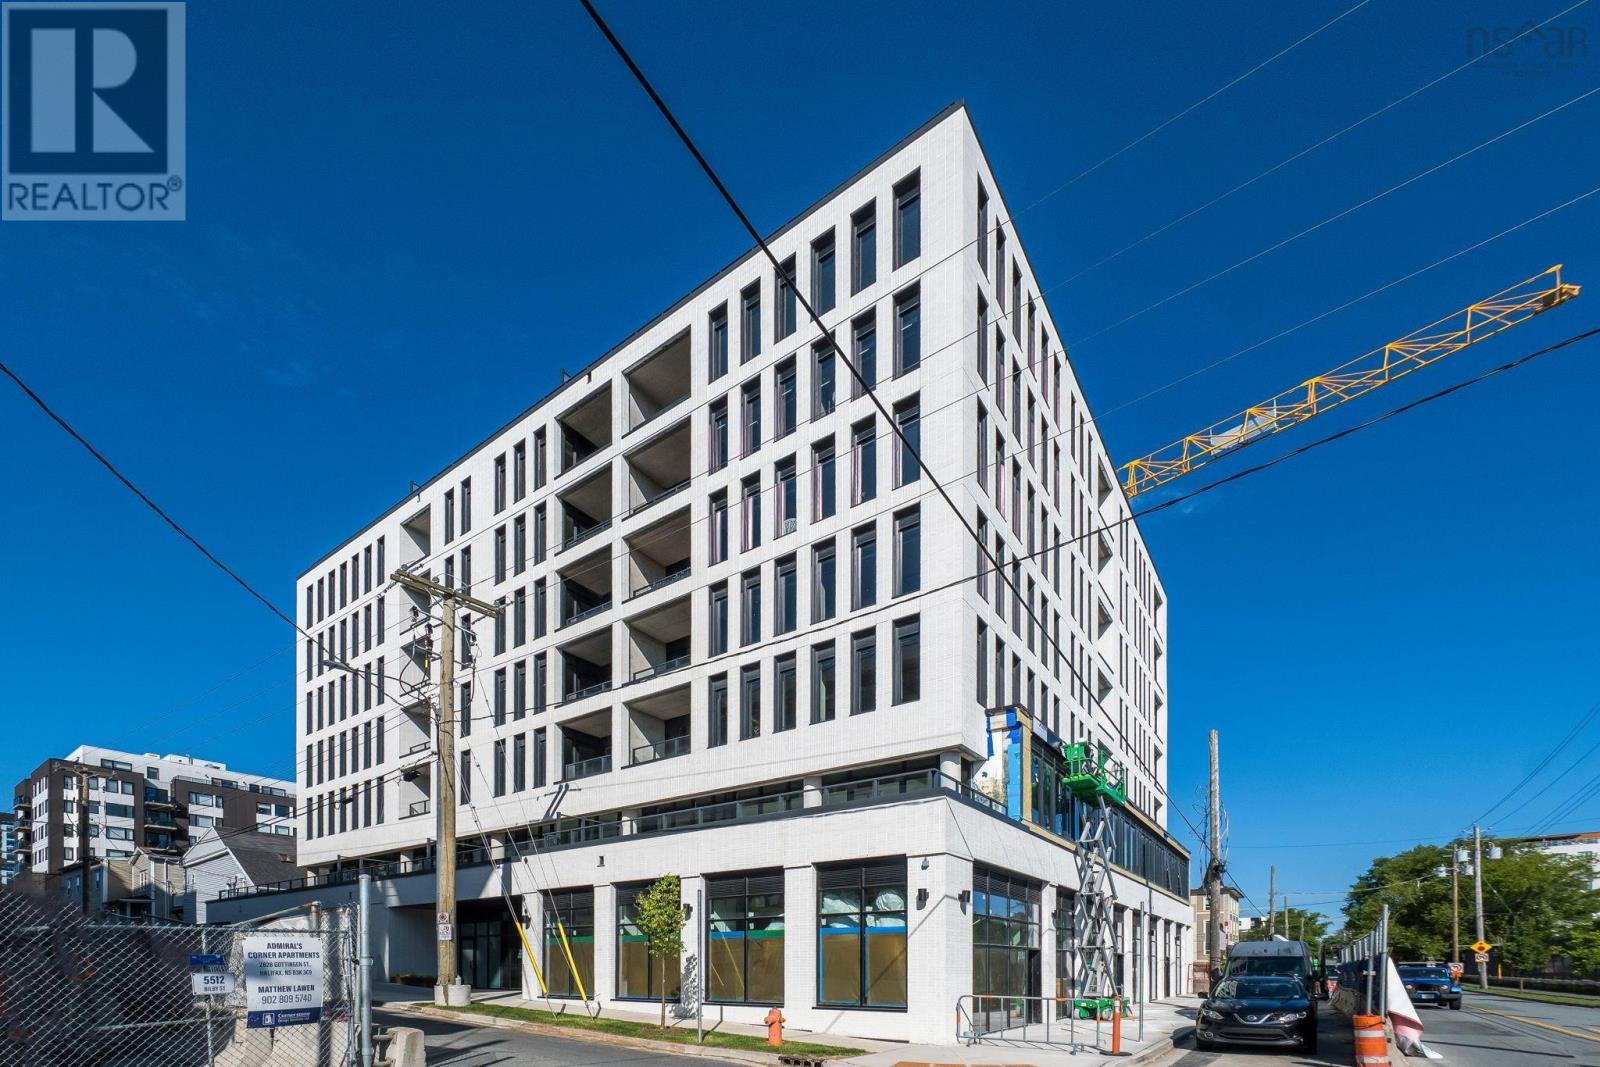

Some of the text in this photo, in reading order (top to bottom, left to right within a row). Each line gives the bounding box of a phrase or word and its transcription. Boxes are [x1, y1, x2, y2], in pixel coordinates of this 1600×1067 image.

[266, 942, 303, 950] ADMIRAL'S
[247, 951, 320, 959] CORNER APARTMENTS
[203, 975, 225, 985] 5512
[257, 984, 315, 993] MATTHEW LAWEN
[261, 993, 312, 1005] 902 809 5740
